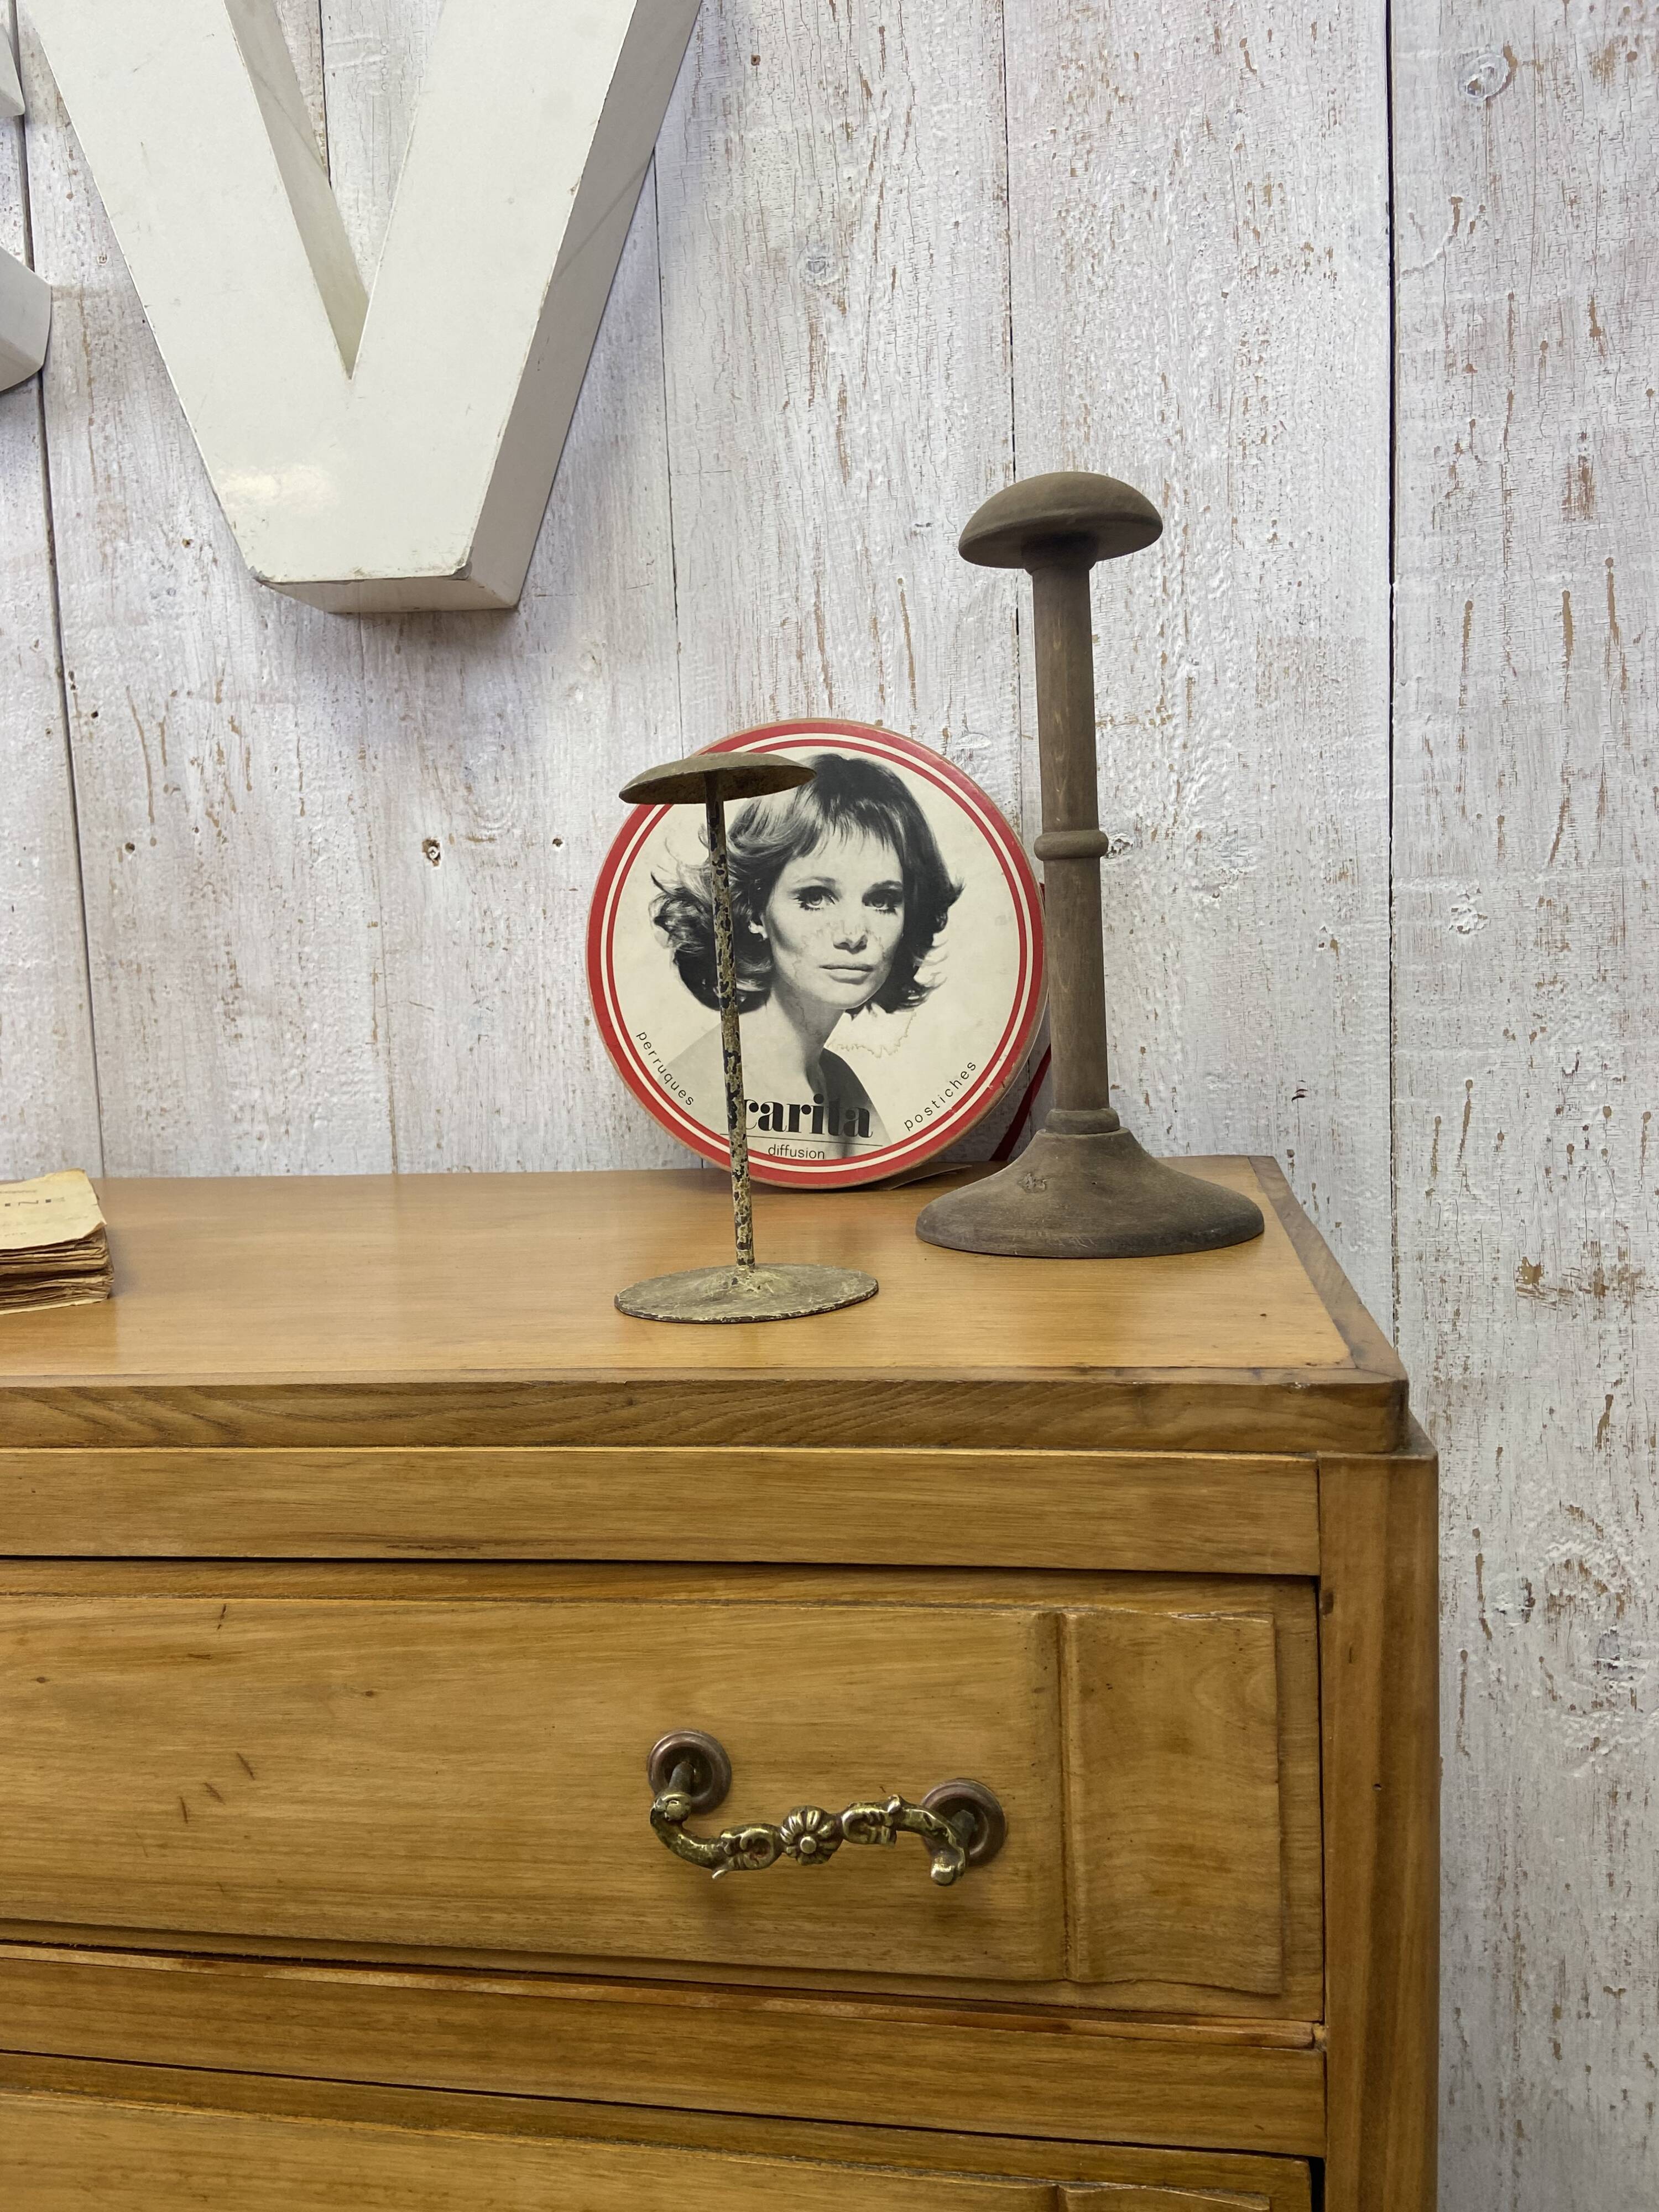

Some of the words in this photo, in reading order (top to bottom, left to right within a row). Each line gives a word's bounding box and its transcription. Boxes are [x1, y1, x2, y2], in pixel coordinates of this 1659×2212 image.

[636, 1031, 693, 1105] perruques
[904, 1062, 976, 1131] postiches
[768, 1144, 825, 1159] diffusion
